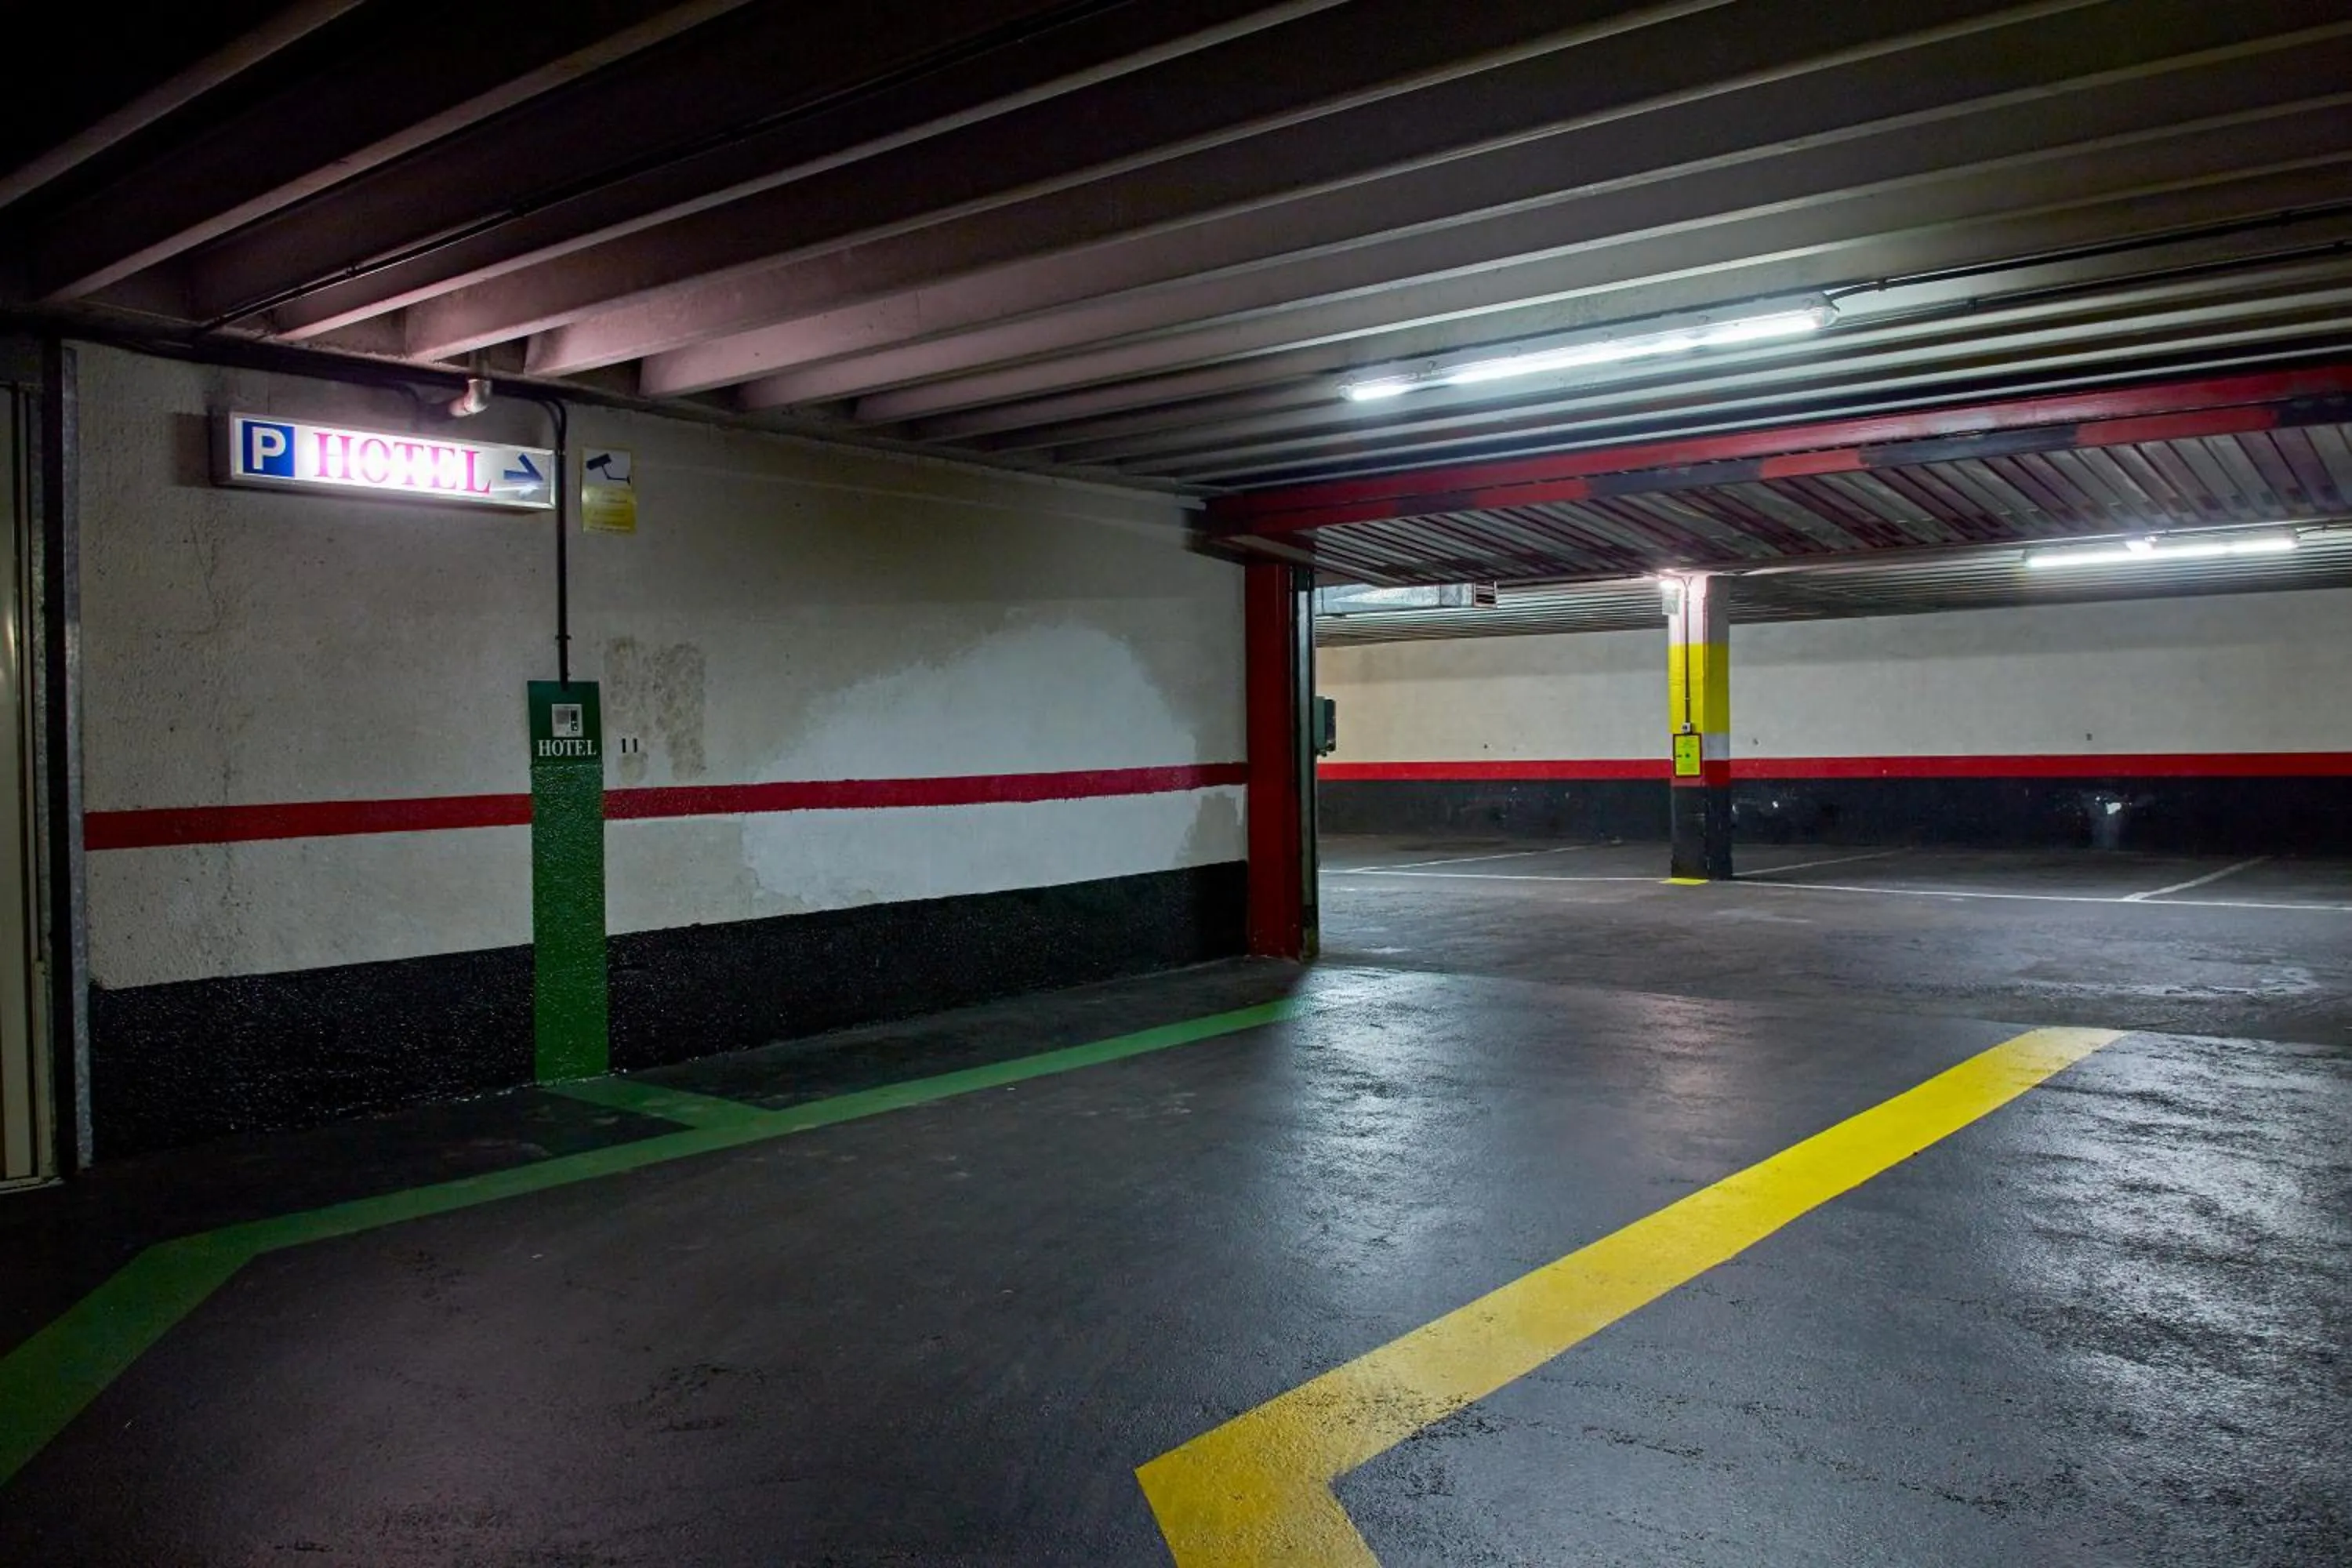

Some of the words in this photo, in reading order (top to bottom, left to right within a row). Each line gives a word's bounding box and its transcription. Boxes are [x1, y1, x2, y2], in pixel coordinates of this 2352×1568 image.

[251, 426, 286, 470] P
[314, 432, 492, 494] HOTEL
[537, 739, 597, 757] HOTEL
